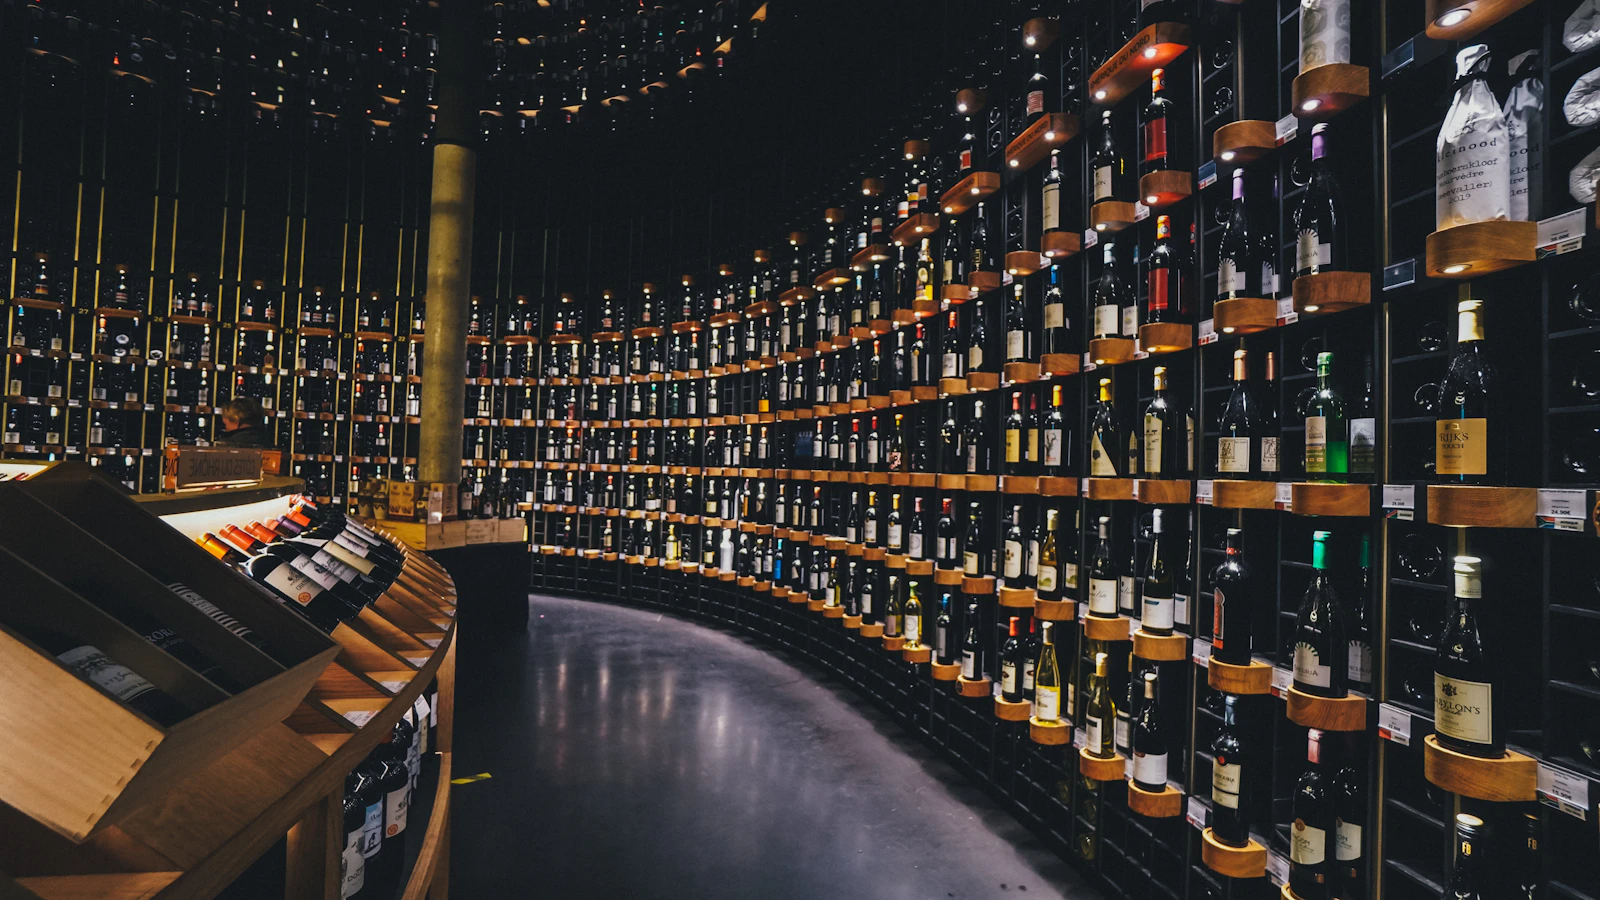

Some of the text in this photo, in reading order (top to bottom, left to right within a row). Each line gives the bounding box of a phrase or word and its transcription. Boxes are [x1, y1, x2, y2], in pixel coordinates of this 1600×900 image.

[1118, 51, 1129, 65] DU
[1129, 34, 1150, 56] NORD
[1448, 193, 1471, 205] 2019
[1461, 841, 1472, 855] FB
